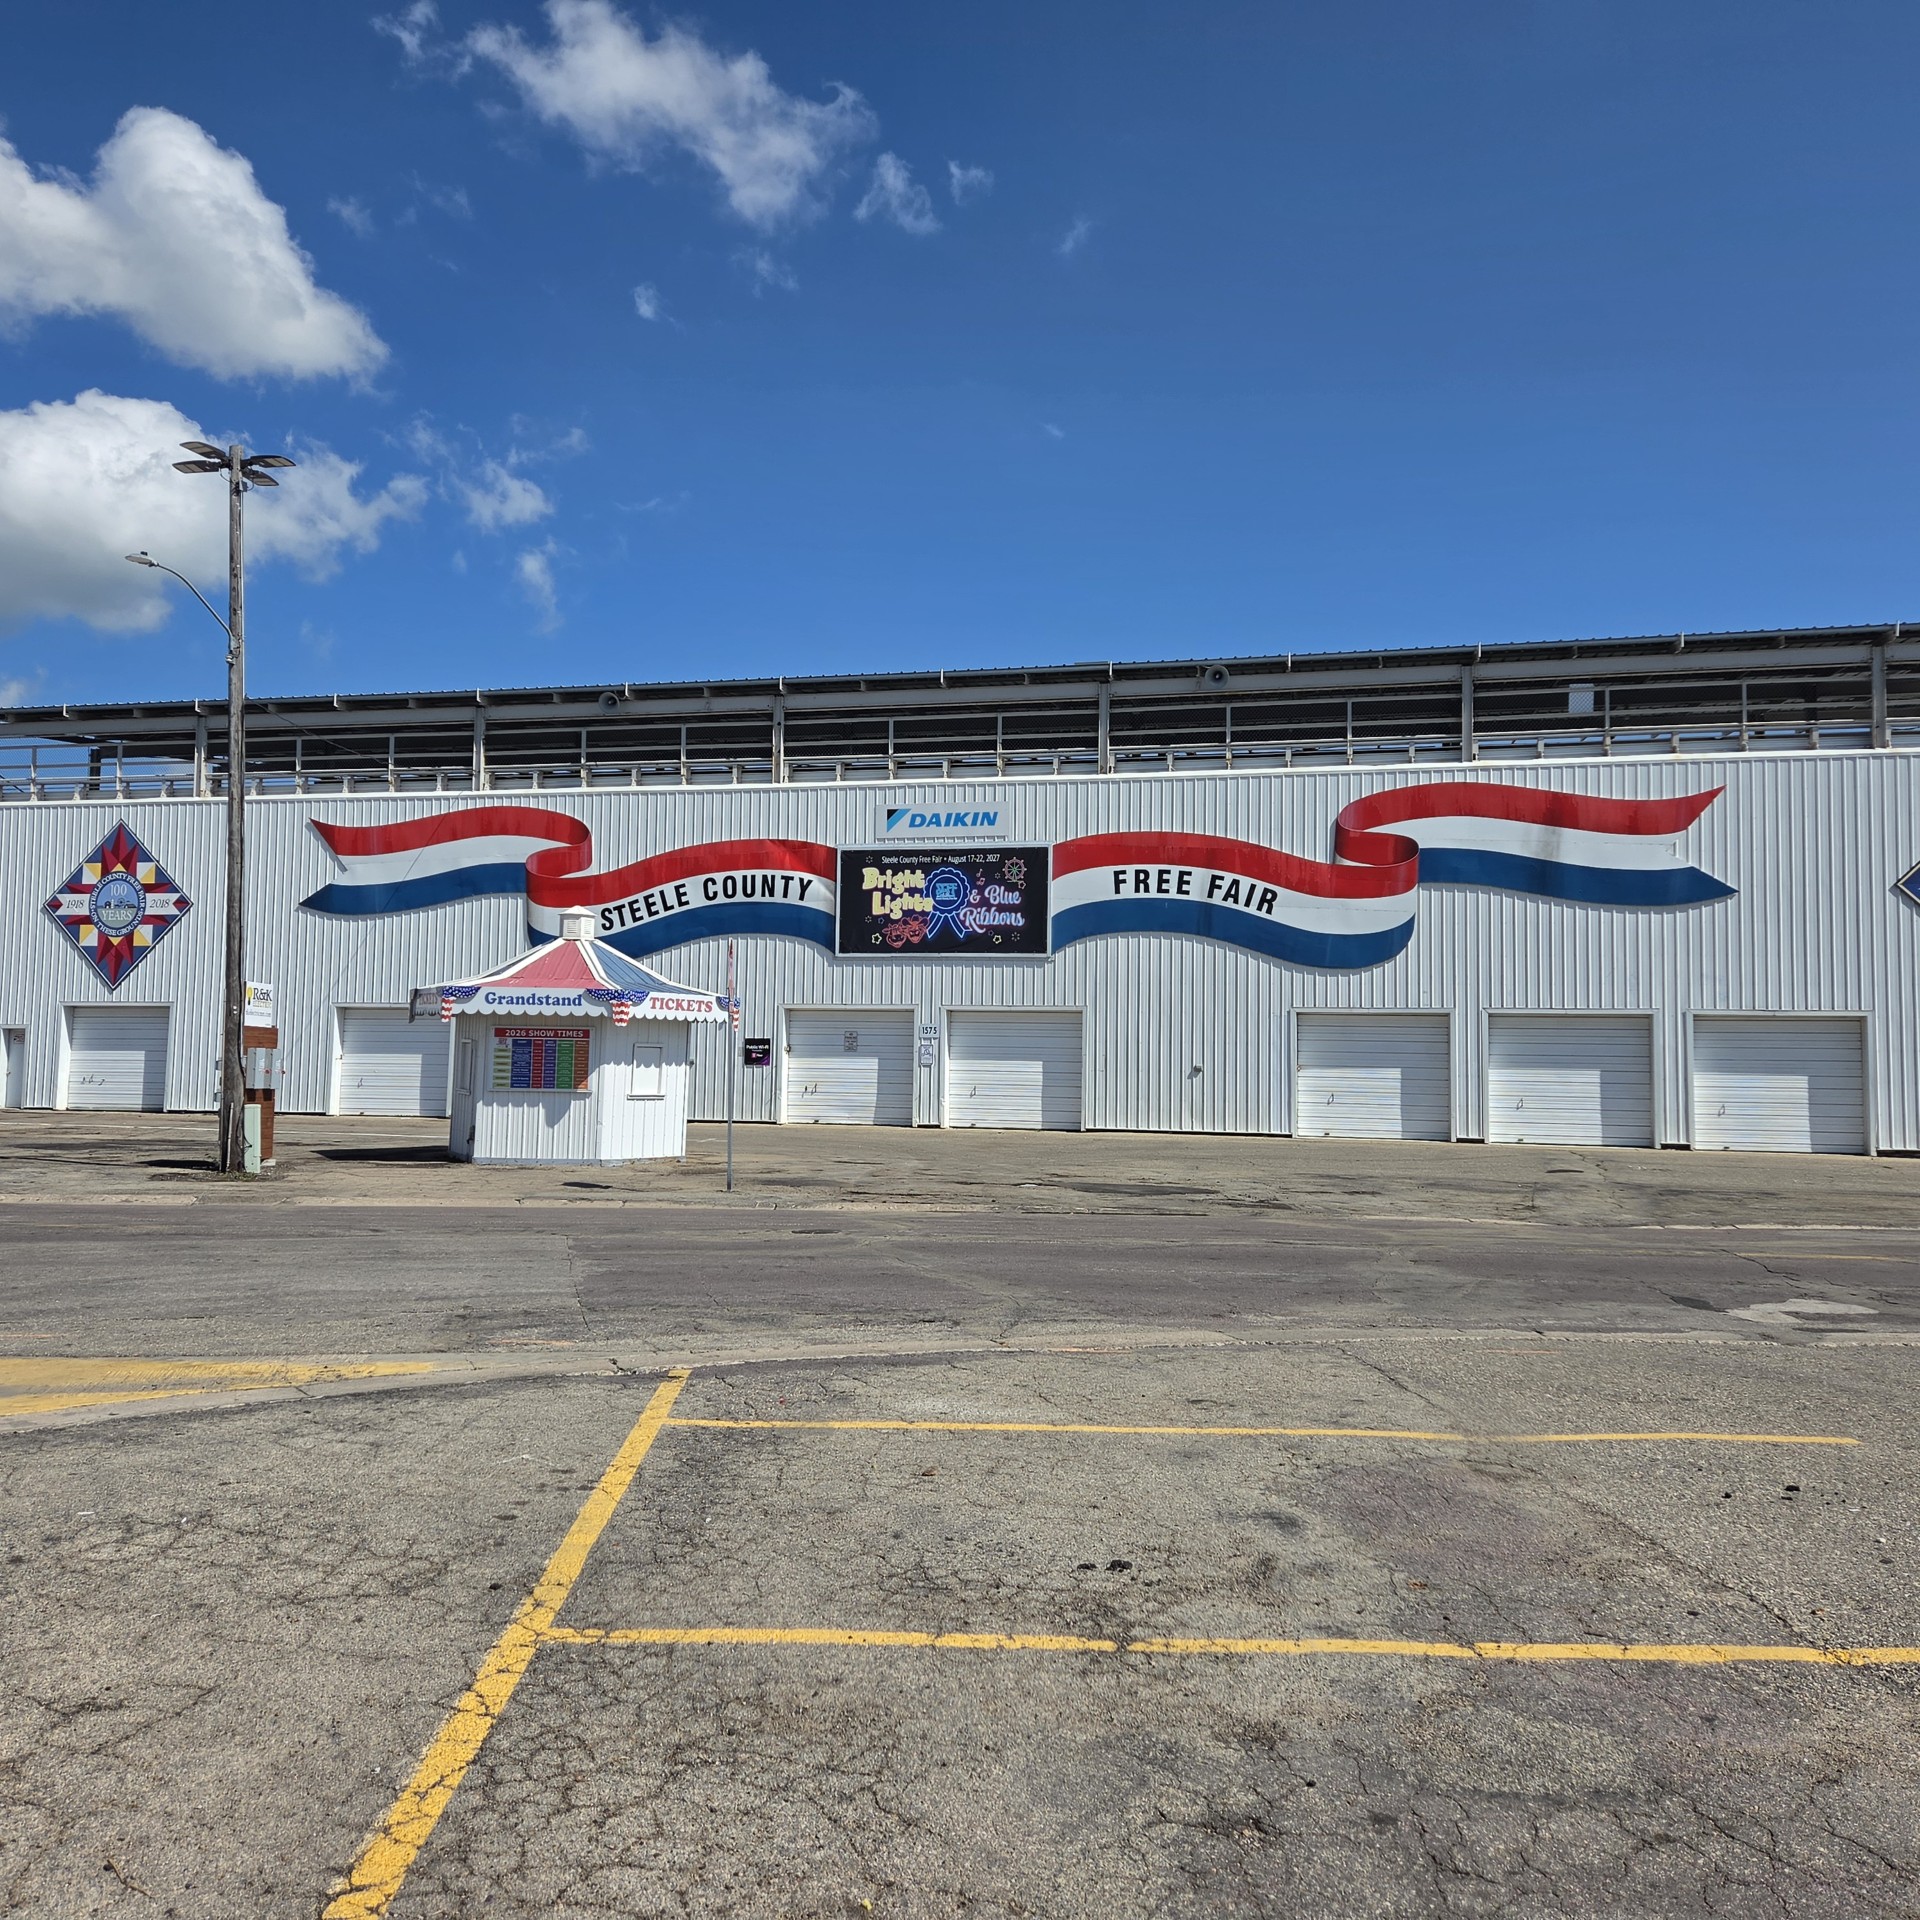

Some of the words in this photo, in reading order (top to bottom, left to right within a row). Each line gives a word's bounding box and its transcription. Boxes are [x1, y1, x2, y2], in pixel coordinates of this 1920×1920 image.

[908, 811, 999, 828] DAIKIN
[881, 855, 898, 864] Steele
[899, 856, 918, 866] County
[932, 855, 942, 863] Fair
[947, 855, 967, 865] August
[967, 854, 985, 863] 17-22,
[986, 854, 1000, 862] 2027
[110, 883, 127, 896] 100
[862, 867, 925, 895] Bright
[90, 881, 103, 909] STEELE
[101, 872, 128, 885] COUNTY
[127, 875, 142, 889] FREE
[138, 888, 146, 907] FAIR
[969, 889, 981, 904] &
[984, 884, 1022, 905] Blue
[1113, 869, 1192, 895] FREE
[1207, 874, 1278, 915] FAIR
[66, 899, 85, 909] 1918
[149, 899, 170, 909] 2018
[600, 883, 690, 931] STEELE
[702, 874, 814, 902] COUNTY
[872, 891, 934, 919] Lights
[91, 911, 99, 922] ON
[97, 922, 116, 936] THESE
[116, 911, 144, 936] GROUNDS
[102, 910, 132, 921] YEARS
[959, 906, 1026, 934] Ribbons
[253, 987, 272, 1001] R&K
[484, 991, 583, 1007] Grandstand
[650, 996, 713, 1013] TICKETS
[505, 1029, 526, 1037] 2026
[528, 1029, 554, 1037] SHOW
[556, 1030, 584, 1038] TIMES
[922, 1026, 937, 1035] 1575
